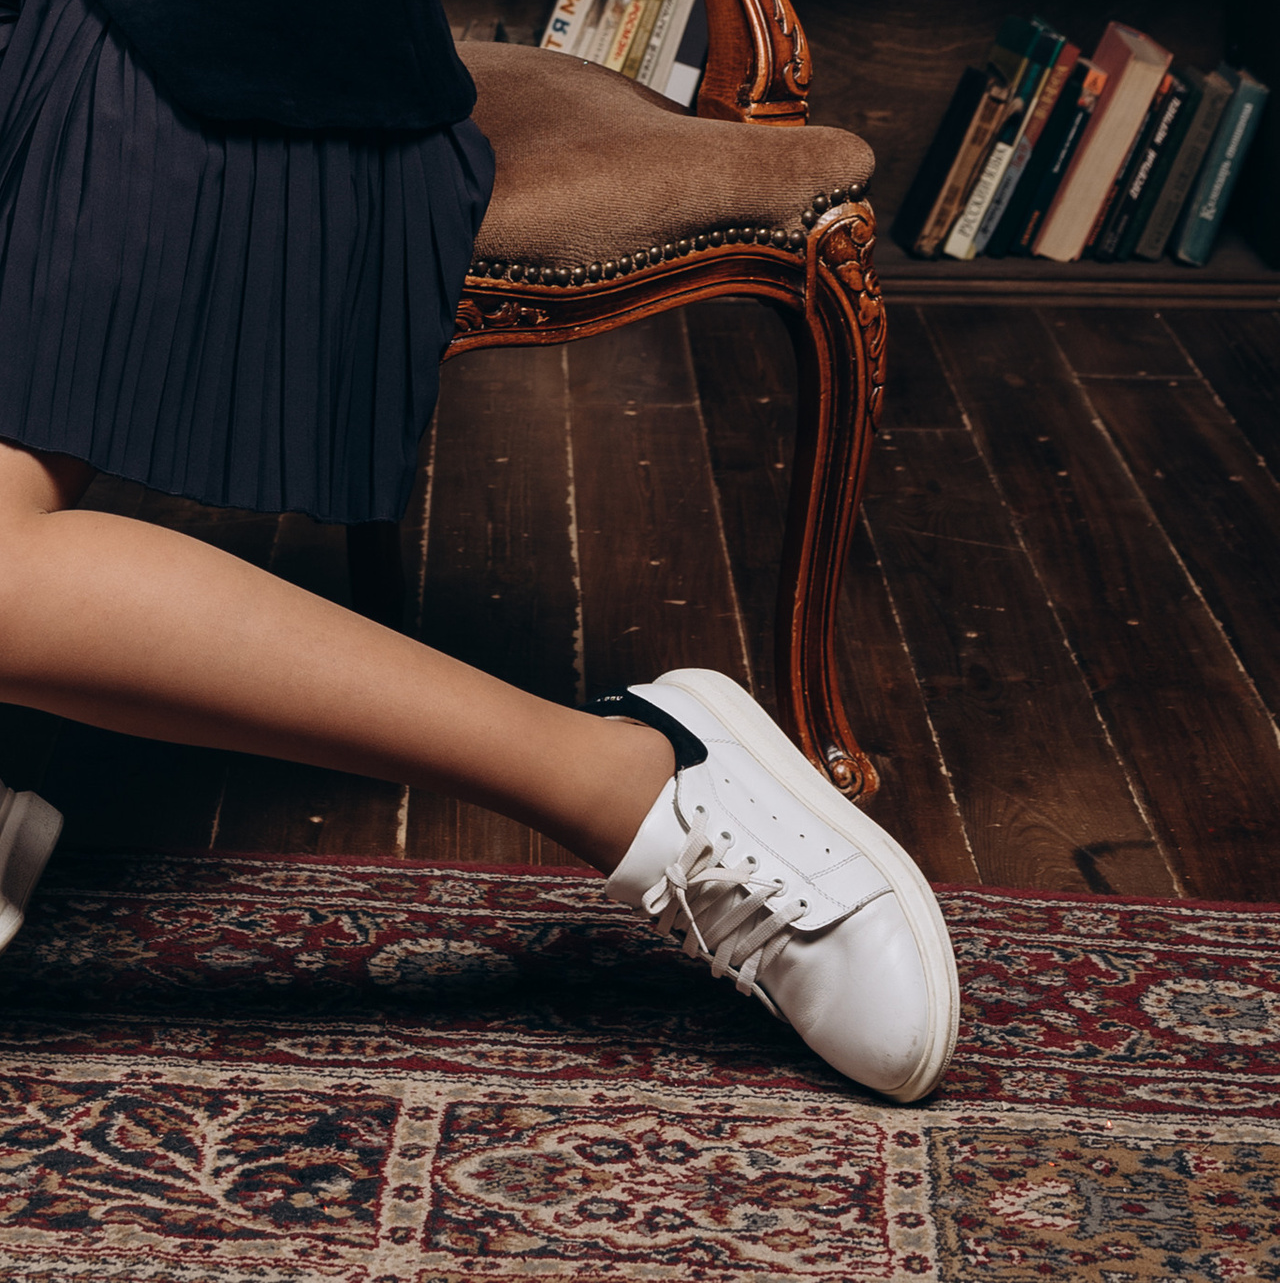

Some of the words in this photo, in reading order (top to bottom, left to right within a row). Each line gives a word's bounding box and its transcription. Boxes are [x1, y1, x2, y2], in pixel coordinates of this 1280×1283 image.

[954, 182, 991, 238] РУССКИЙ
[978, 142, 1009, 187] ЯЗЫК
[1125, 147, 1159, 200] ДЕСЯТЫЙ
